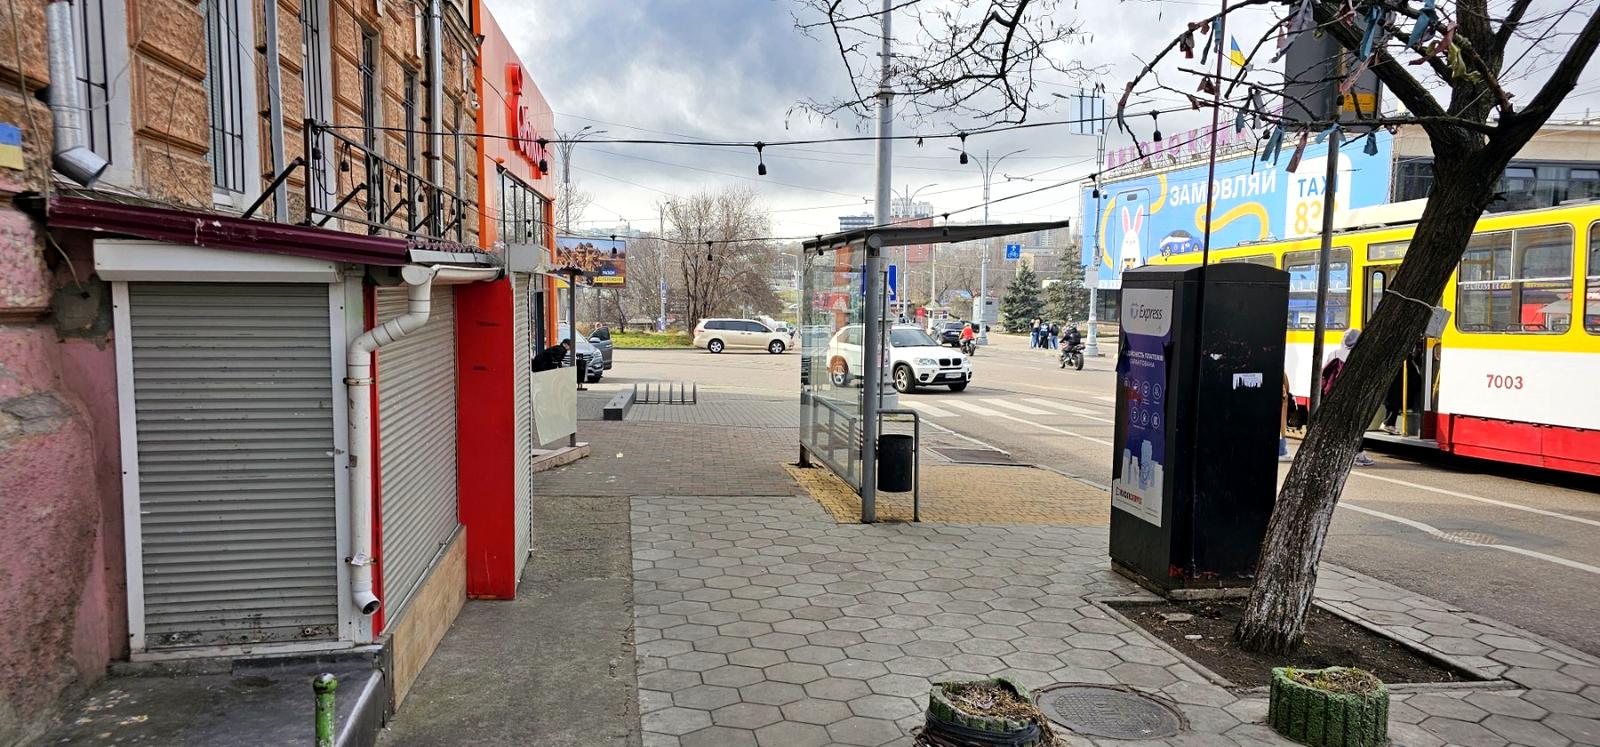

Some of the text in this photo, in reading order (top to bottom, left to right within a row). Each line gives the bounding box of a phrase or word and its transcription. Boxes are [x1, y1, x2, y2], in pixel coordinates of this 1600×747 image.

[1295, 200, 1339, 235] 83
[1140, 304, 1163, 321] Express
[1486, 374, 1523, 390] 7003
